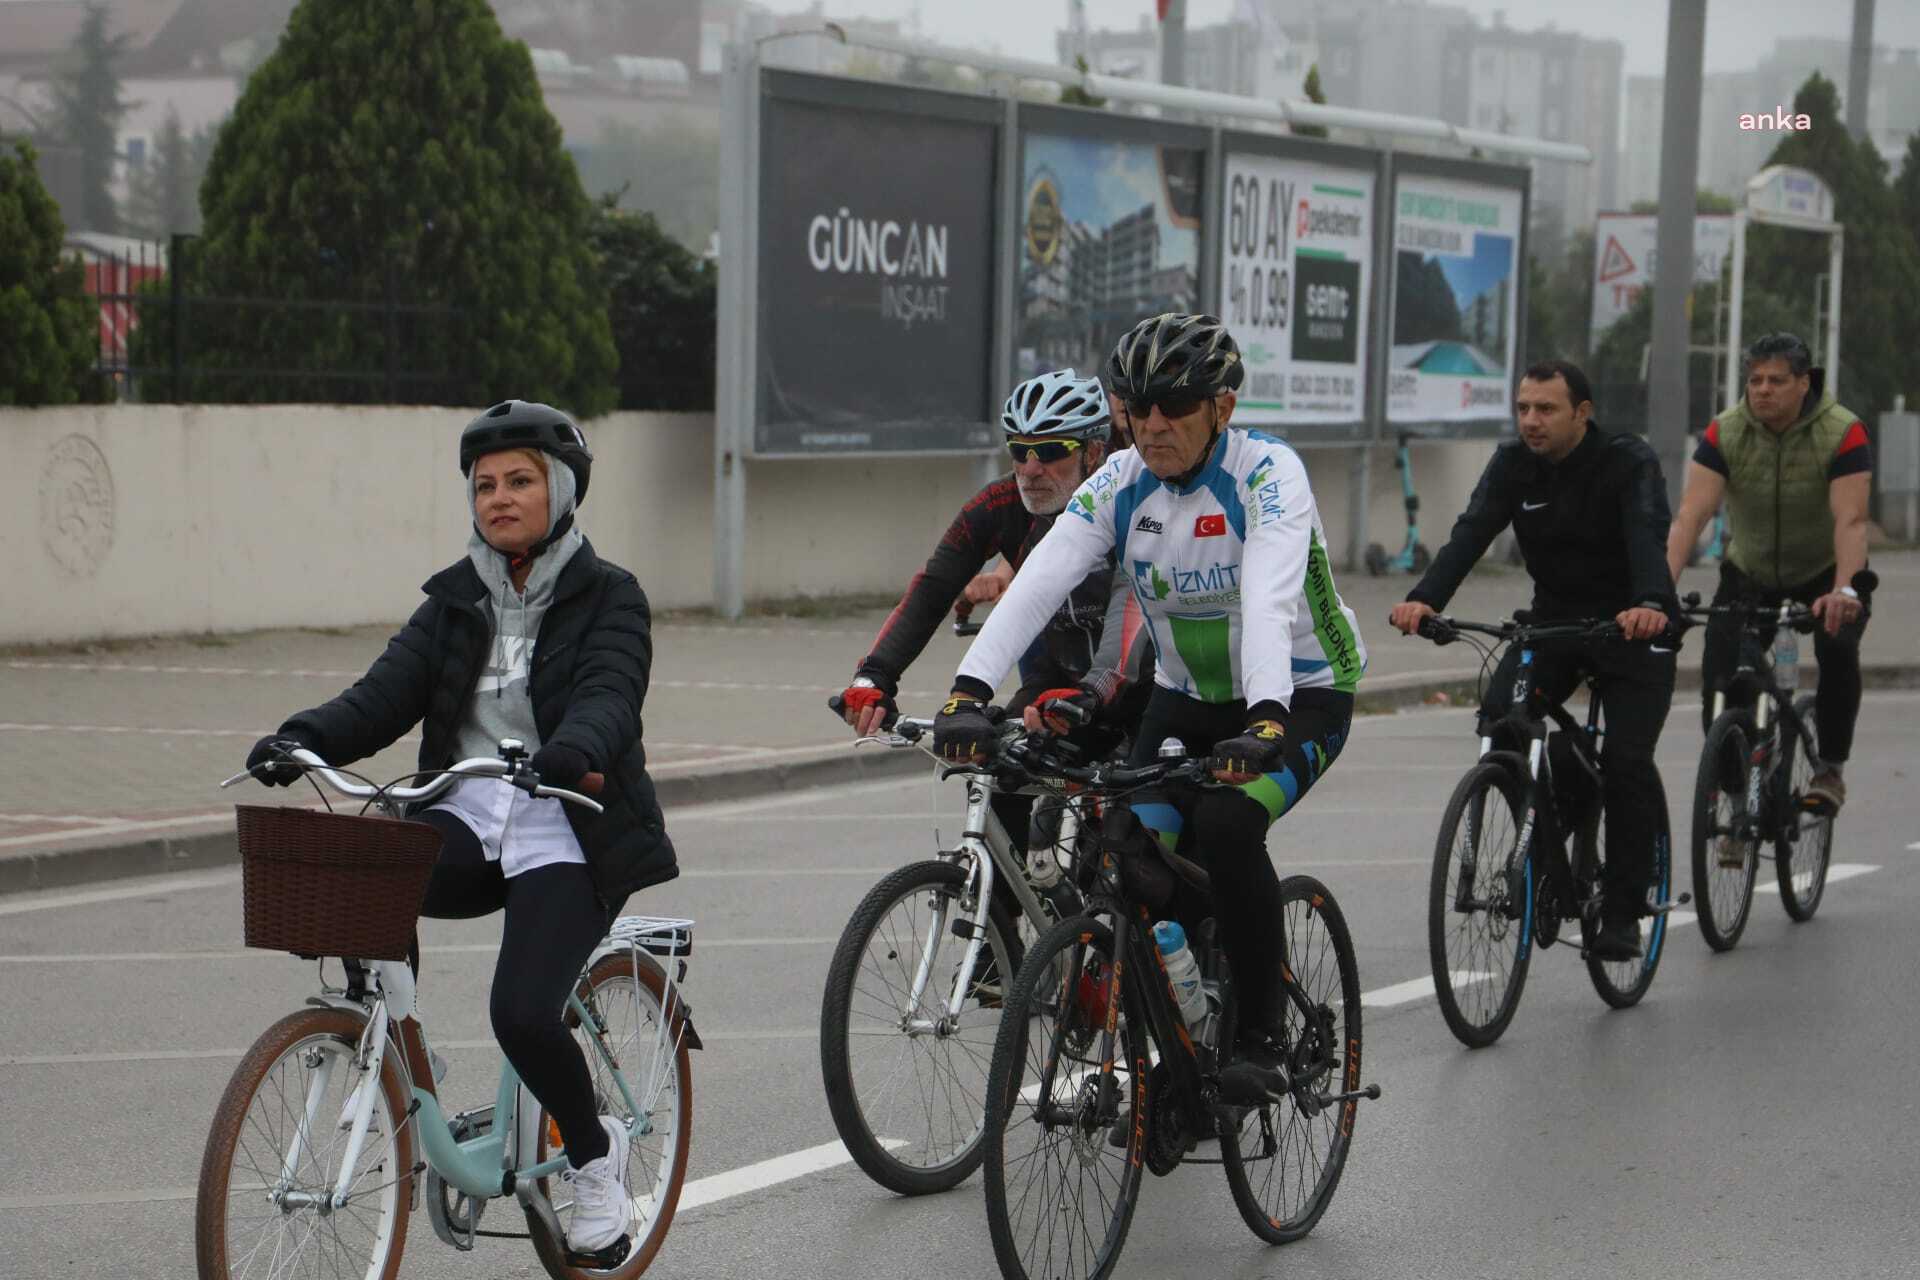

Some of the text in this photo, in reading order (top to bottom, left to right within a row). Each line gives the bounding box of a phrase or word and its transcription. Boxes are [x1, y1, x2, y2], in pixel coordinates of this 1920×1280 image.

[808, 208, 949, 279] GÜNCAN
[1230, 173, 1261, 257] 60
[1263, 178, 1294, 262] AY
[1172, 562, 1239, 593] İZMİT
